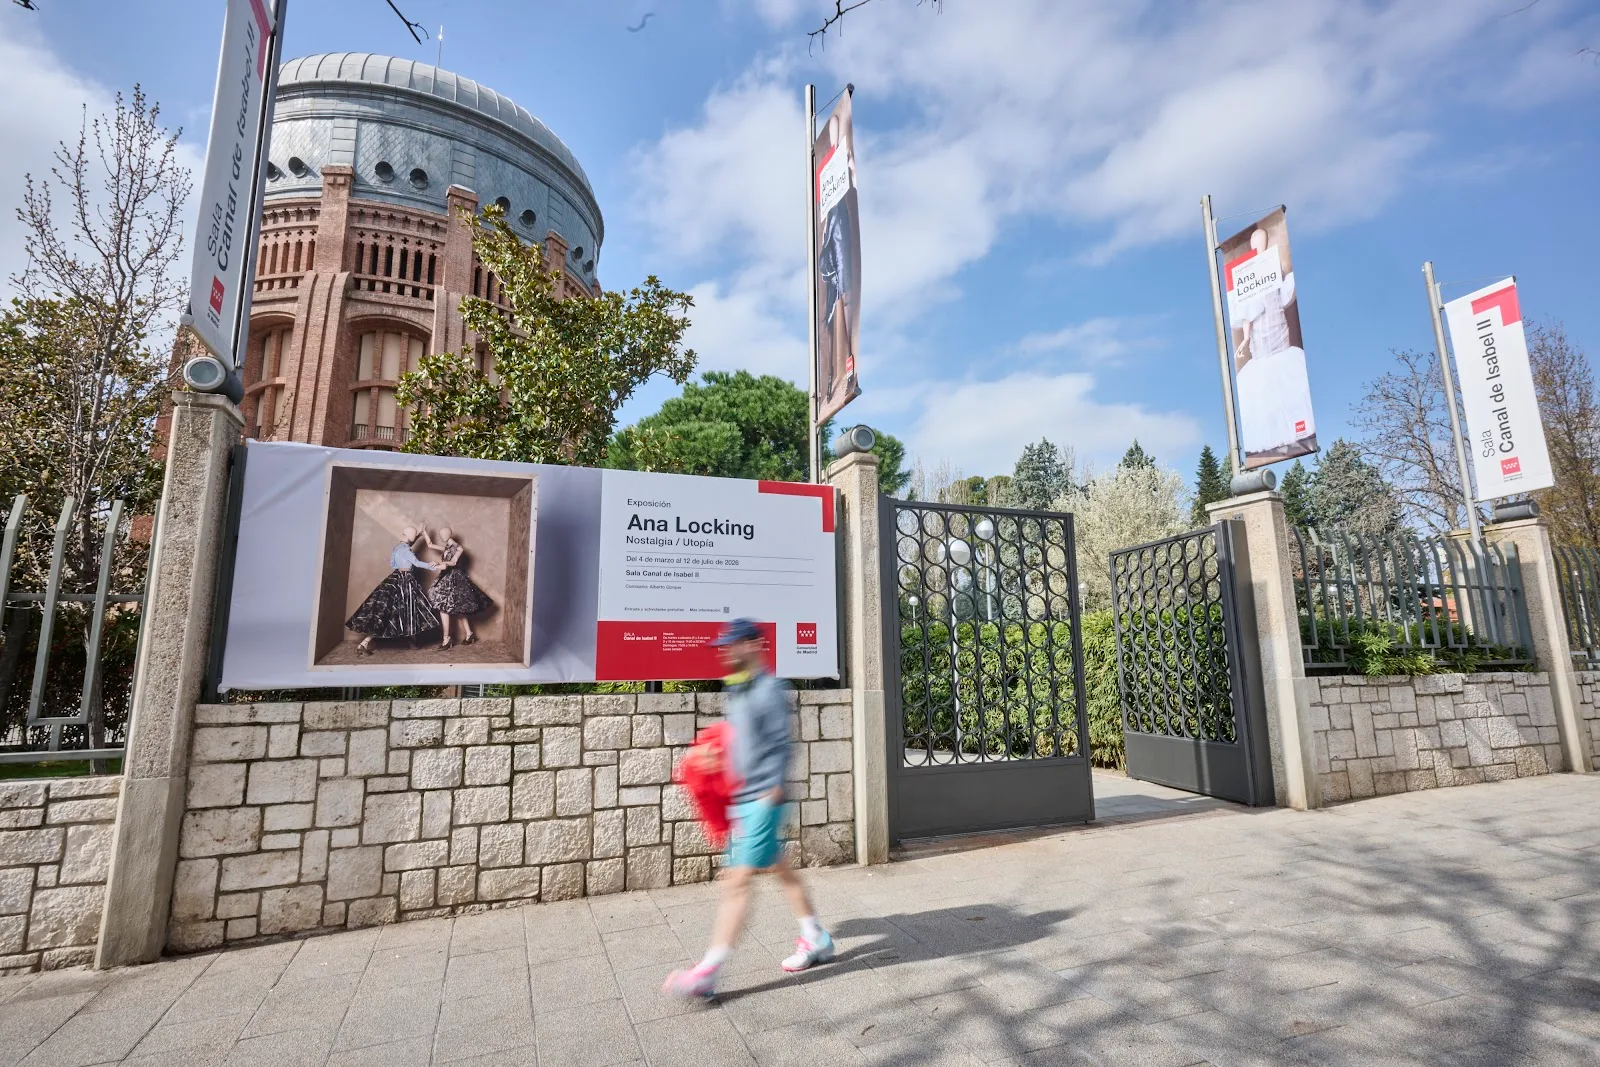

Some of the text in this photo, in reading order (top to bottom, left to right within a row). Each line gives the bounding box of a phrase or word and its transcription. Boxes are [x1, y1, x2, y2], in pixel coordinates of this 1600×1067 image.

[217, 20, 255, 272] Canal de Isabel II
[207, 202, 223, 257] Sala
[1236, 272, 1256, 286] Ana
[1236, 271, 1277, 297] Locking
[1476, 318, 1492, 331] II
[1478, 332, 1501, 380] Isabel
[1489, 383, 1505, 403] de
[1492, 406, 1514, 453] Canal
[1482, 429, 1495, 458] Sala
[627, 498, 671, 508] Exposición
[627, 513, 754, 540] Ana Locking
[626, 535, 714, 548] Nostalgia / Utopía
[701, 558, 714, 566] julio
